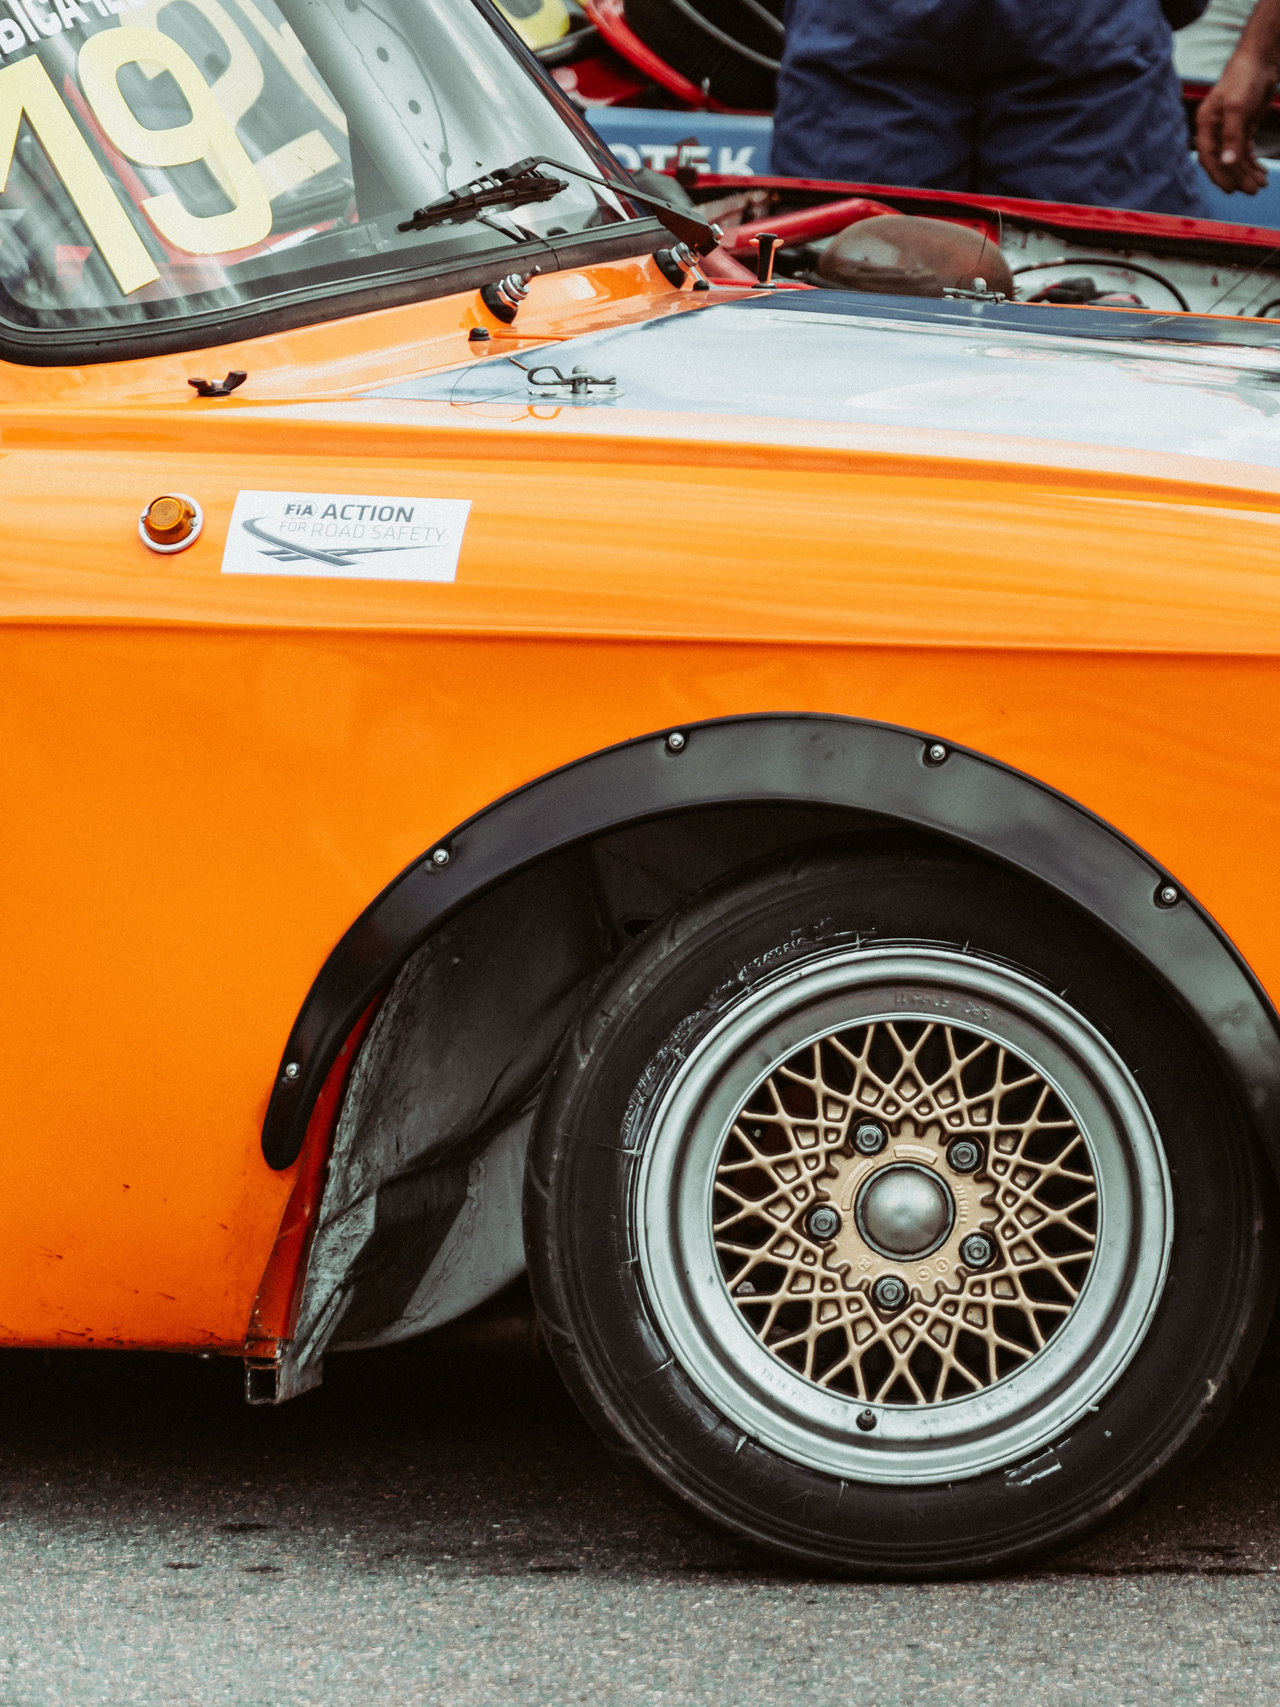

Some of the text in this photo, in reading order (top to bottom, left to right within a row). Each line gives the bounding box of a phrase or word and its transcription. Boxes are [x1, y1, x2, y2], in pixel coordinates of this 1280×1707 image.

[0, 27, 273, 295] 19
[320, 503, 415, 523] ACTION
[279, 520, 447, 543] FOR ROAD SAFETY
